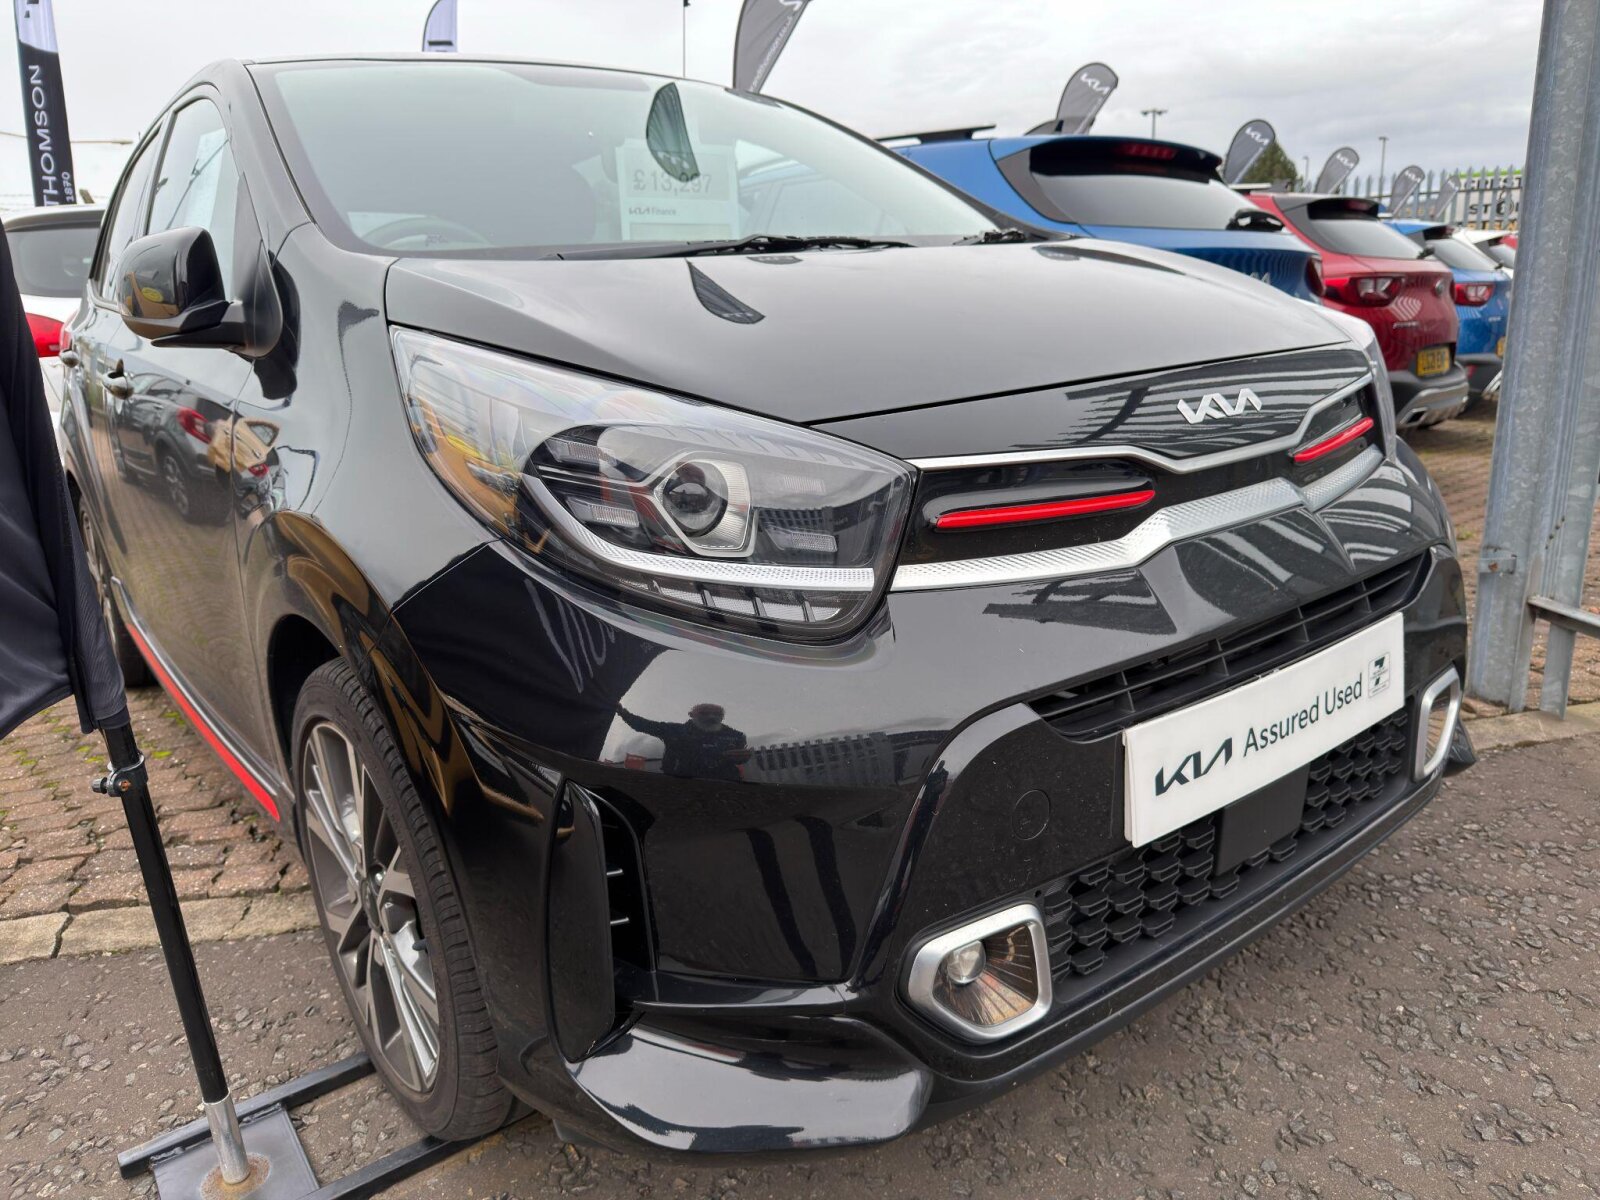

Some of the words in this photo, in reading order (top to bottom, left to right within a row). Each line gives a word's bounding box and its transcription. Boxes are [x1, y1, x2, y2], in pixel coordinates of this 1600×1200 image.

[29, 65, 59, 206] THOMSON
[61, 171, 74, 202] 1870
[1176, 388, 1263, 424] KIA
[1155, 737, 1233, 797] KIA
[1243, 695, 1320, 758] Assured
[1324, 672, 1363, 716] Used
